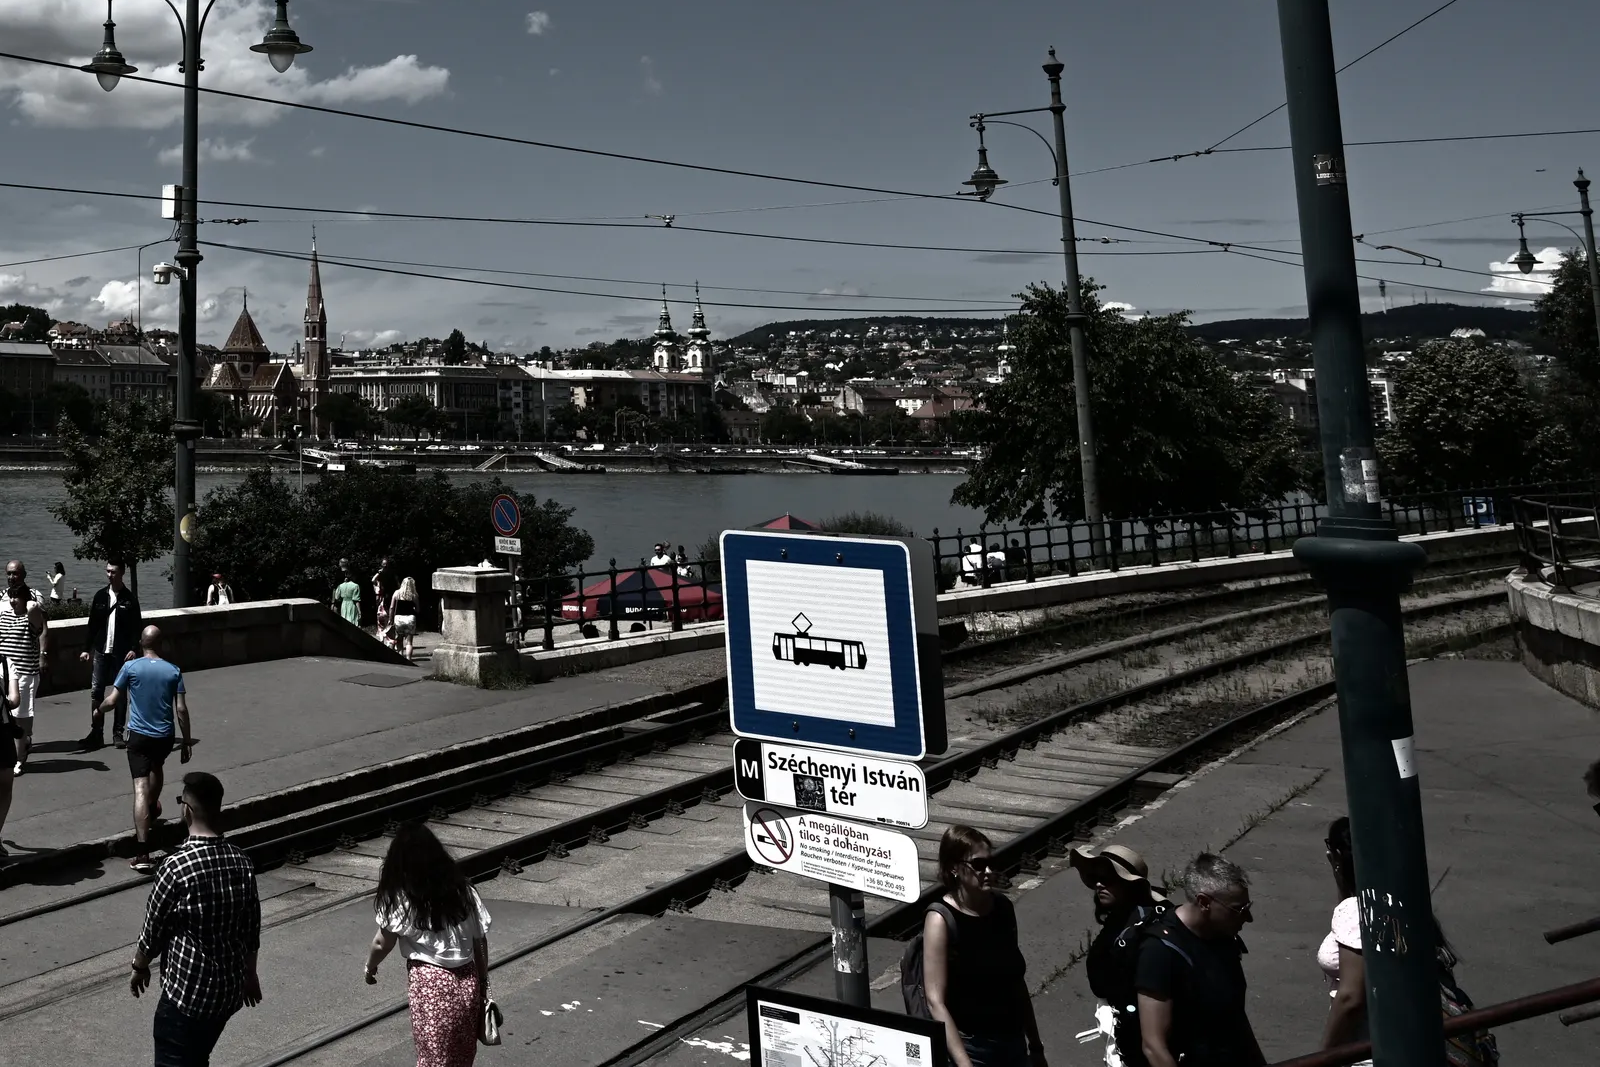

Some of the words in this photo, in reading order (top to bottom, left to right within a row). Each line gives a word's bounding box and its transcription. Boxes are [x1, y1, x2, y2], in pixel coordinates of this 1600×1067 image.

[741, 758, 759, 780] M
[767, 751, 857, 786] Széchenyi
[863, 766, 920, 793] István
[830, 784, 857, 807] tér
[798, 816, 806, 827] A
[809, 820, 869, 841] megállóban
[799, 829, 821, 843] tilos
[824, 836, 830, 845] a
[833, 837, 892, 860] dohányzás!
[800, 850, 823, 861] Rauchen
[823, 856, 847, 867] verboten
[808, 845, 831, 856] smoking
[834, 851, 866, 863] Interdiction
[874, 859, 891, 869] fumer
[866, 876, 876, 885] +36
[876, 879, 884, 887] 80
[884, 880, 894, 889] 200
[895, 884, 906, 892] 493
